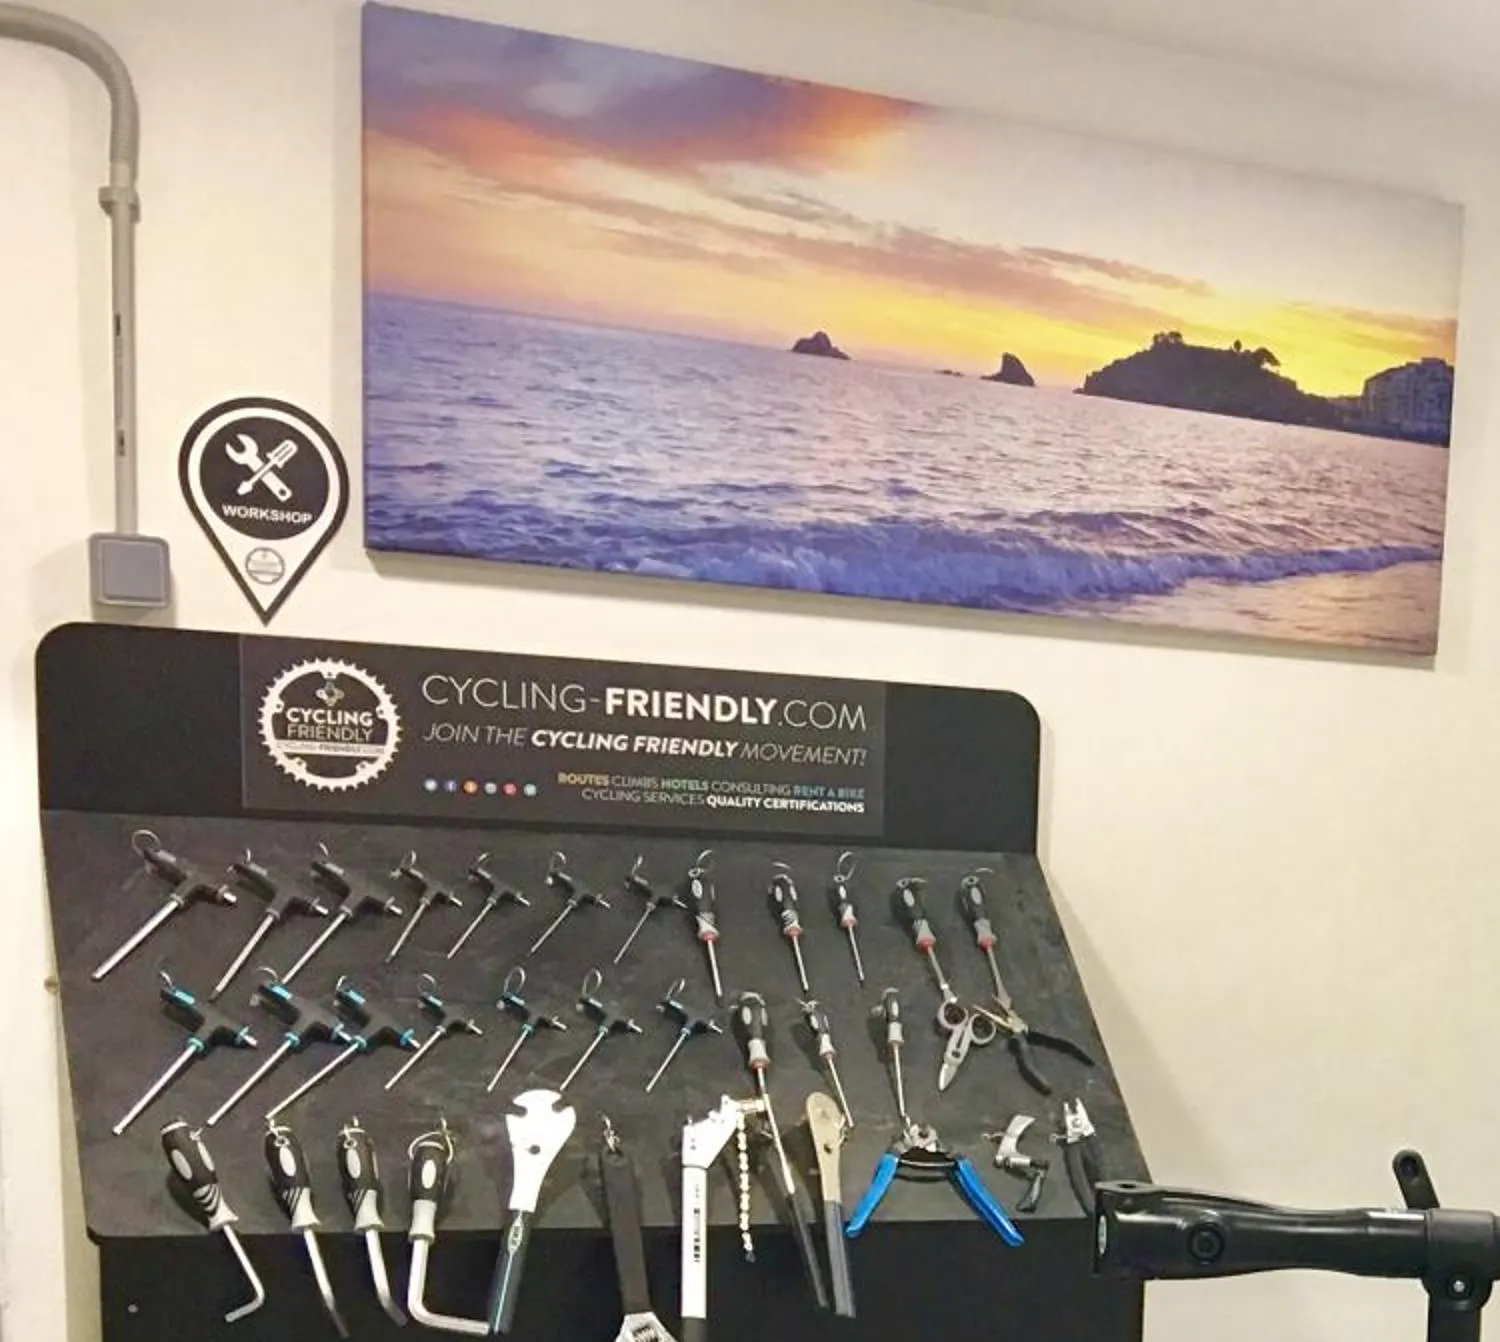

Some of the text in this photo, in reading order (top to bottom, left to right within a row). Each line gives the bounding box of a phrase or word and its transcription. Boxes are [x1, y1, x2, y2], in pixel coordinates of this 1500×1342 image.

[221, 503, 313, 524] WORKSHOP
[421, 674, 867, 731] CYCLING-FRIENDLY.COM
[285, 706, 374, 727] CYCLING
[286, 723, 373, 743] FRIENDLY
[422, 722, 868, 767] JOIN THE CYCLING FRIENDLY MOVEMENT!
[557, 772, 609, 786] ROUTES
[660, 778, 708, 791] HOTELS
[581, 788, 641, 803] CYCLING
[706, 794, 762, 809] QUALITY
[763, 797, 865, 814] CERTIFICATIONS
